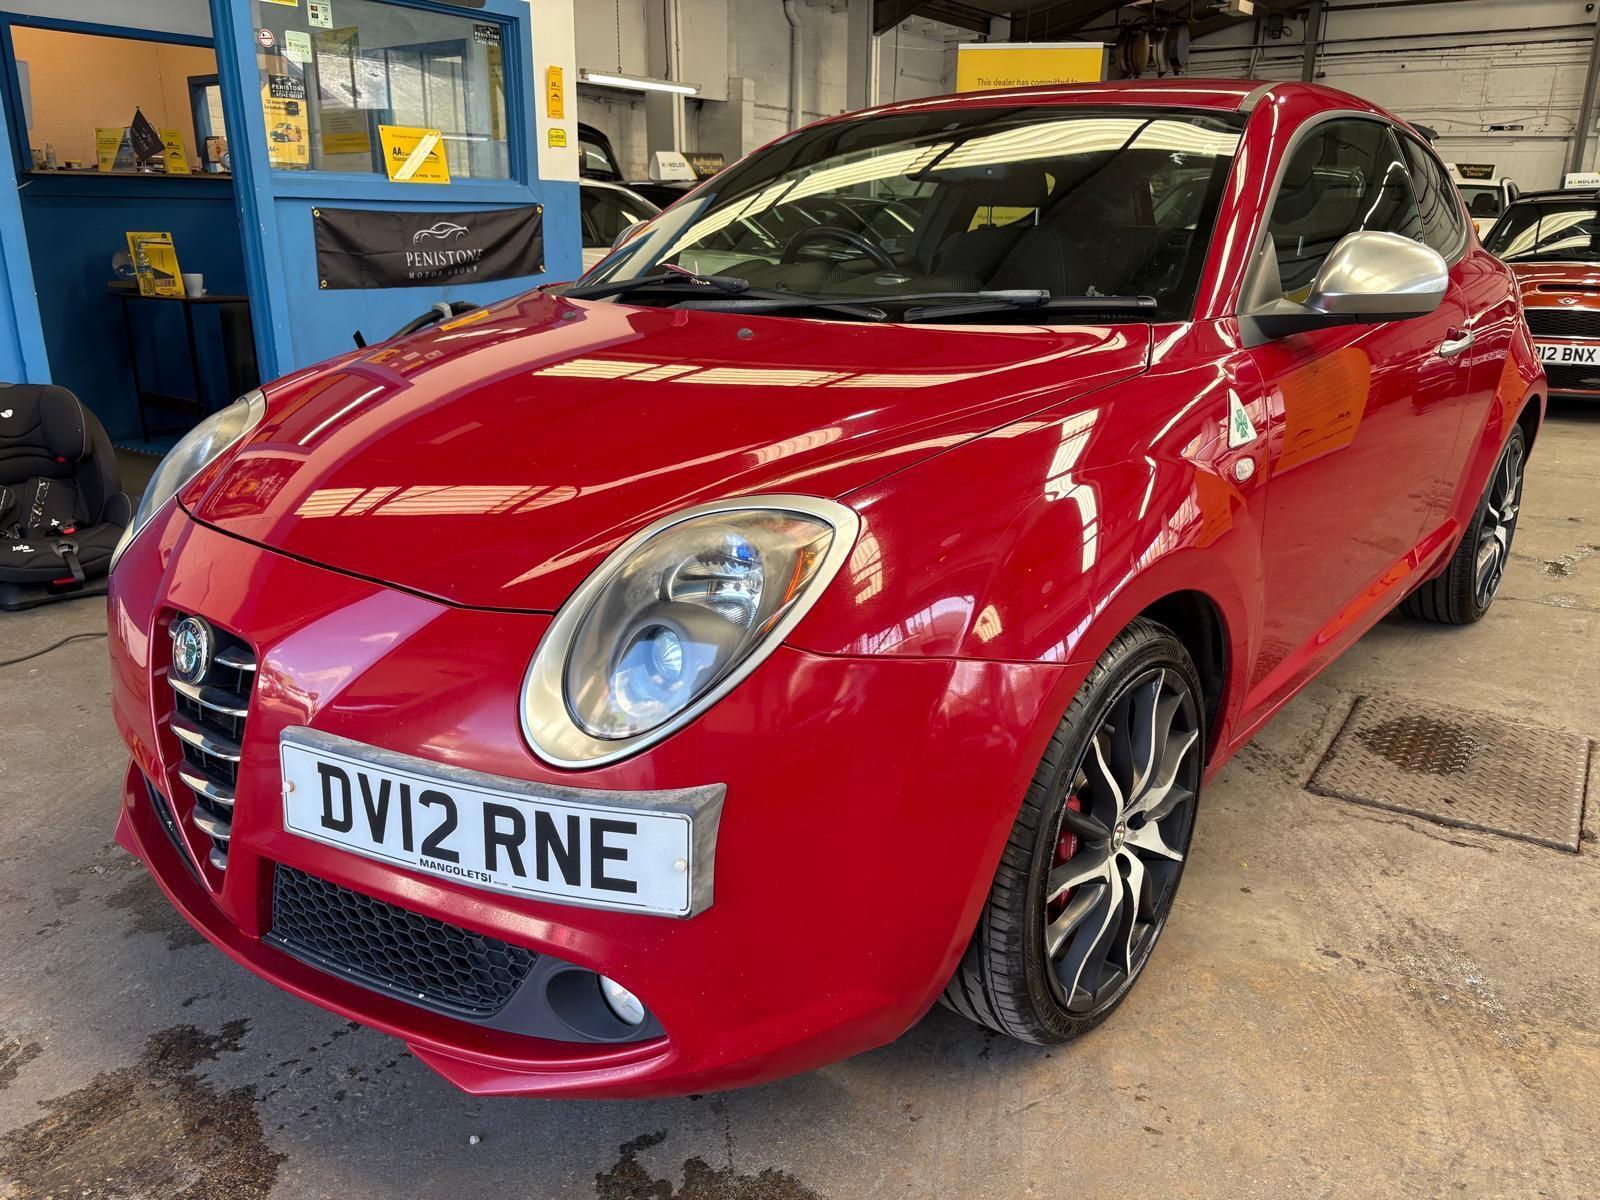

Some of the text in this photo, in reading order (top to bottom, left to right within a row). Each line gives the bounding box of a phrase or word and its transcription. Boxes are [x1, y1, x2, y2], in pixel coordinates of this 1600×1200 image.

[271, 83, 306, 92] PENISTONE
[977, 78, 991, 86] This
[993, 78, 1015, 86] dealer
[1016, 78, 1029, 86] has
[392, 146, 402, 156] AA
[405, 249, 484, 267] PENISTONE
[409, 271, 443, 279] MOTOR
[1561, 347, 1597, 363] BNX
[316, 761, 638, 894] DV12 RNE
[419, 858, 492, 883] MANGOLETSI
